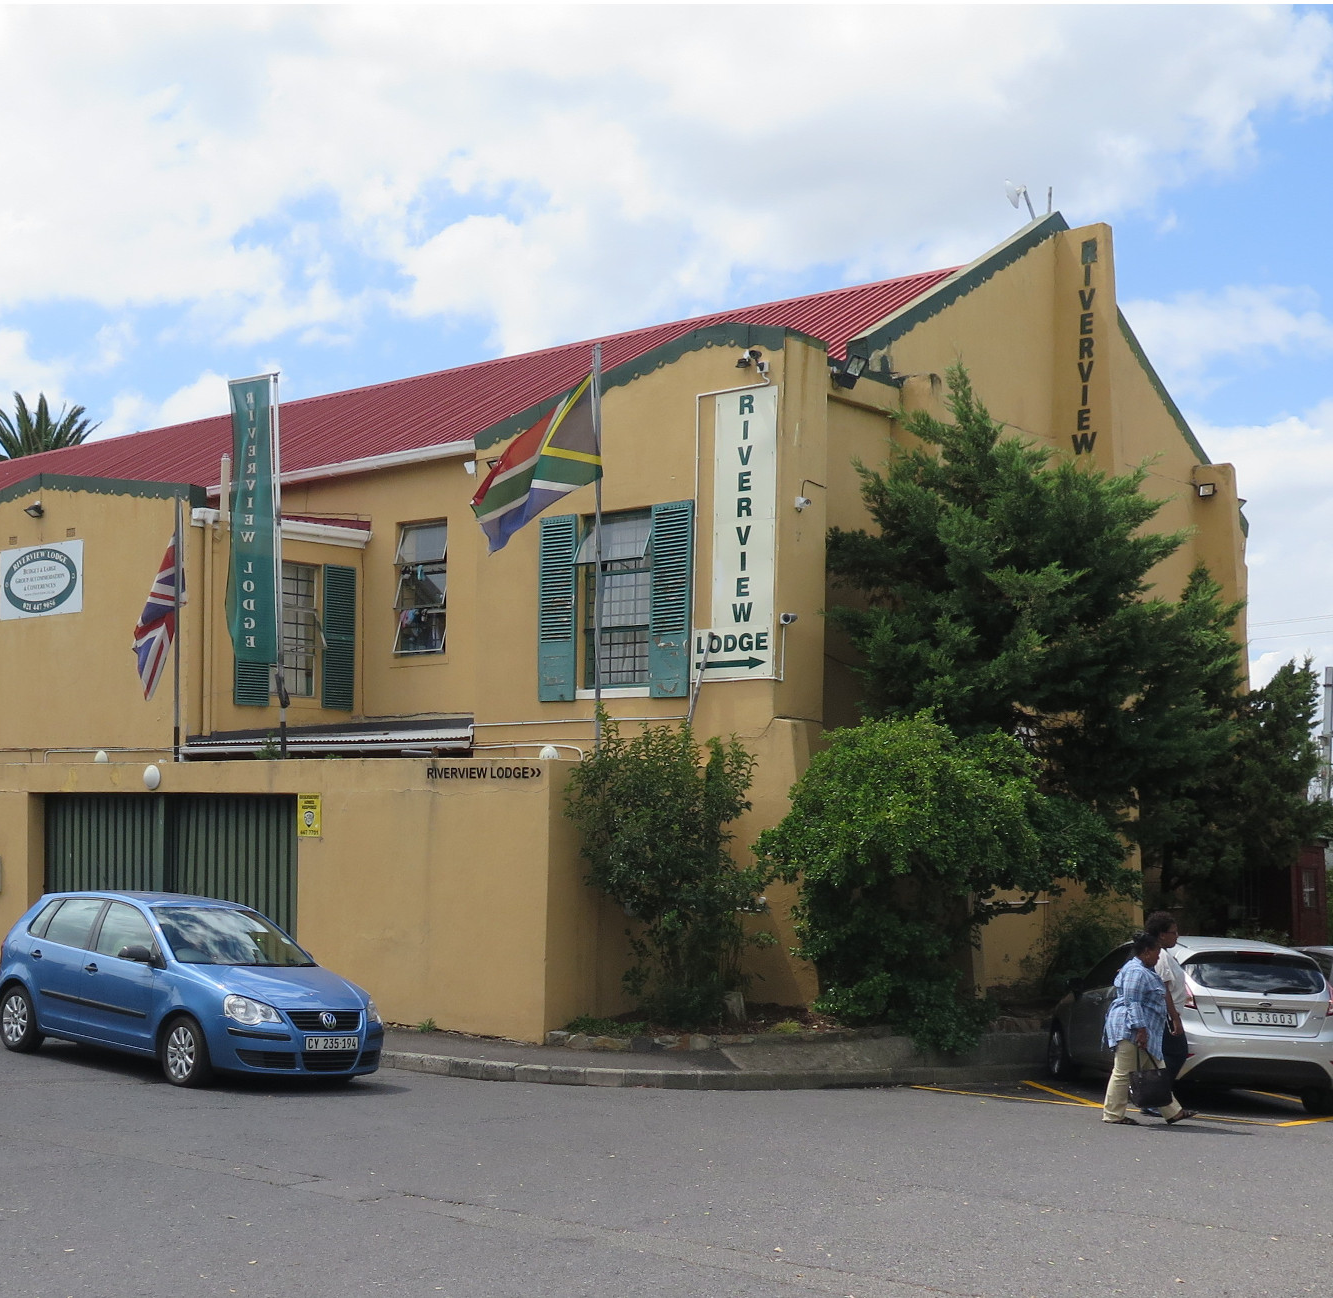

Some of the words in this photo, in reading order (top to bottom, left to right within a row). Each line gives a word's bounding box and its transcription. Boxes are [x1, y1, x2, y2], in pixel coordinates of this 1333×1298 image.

[1071, 238, 1097, 455] RIVERVIEW
[731, 393, 755, 623] RIVERVIEW
[13, 551, 45, 571] RIVERVIEW
[47, 550, 67, 565] LODGE
[696, 632, 769, 653] LODGE
[427, 767, 487, 779] RIVERVIEW
[308, 1038, 319, 1049] CY
